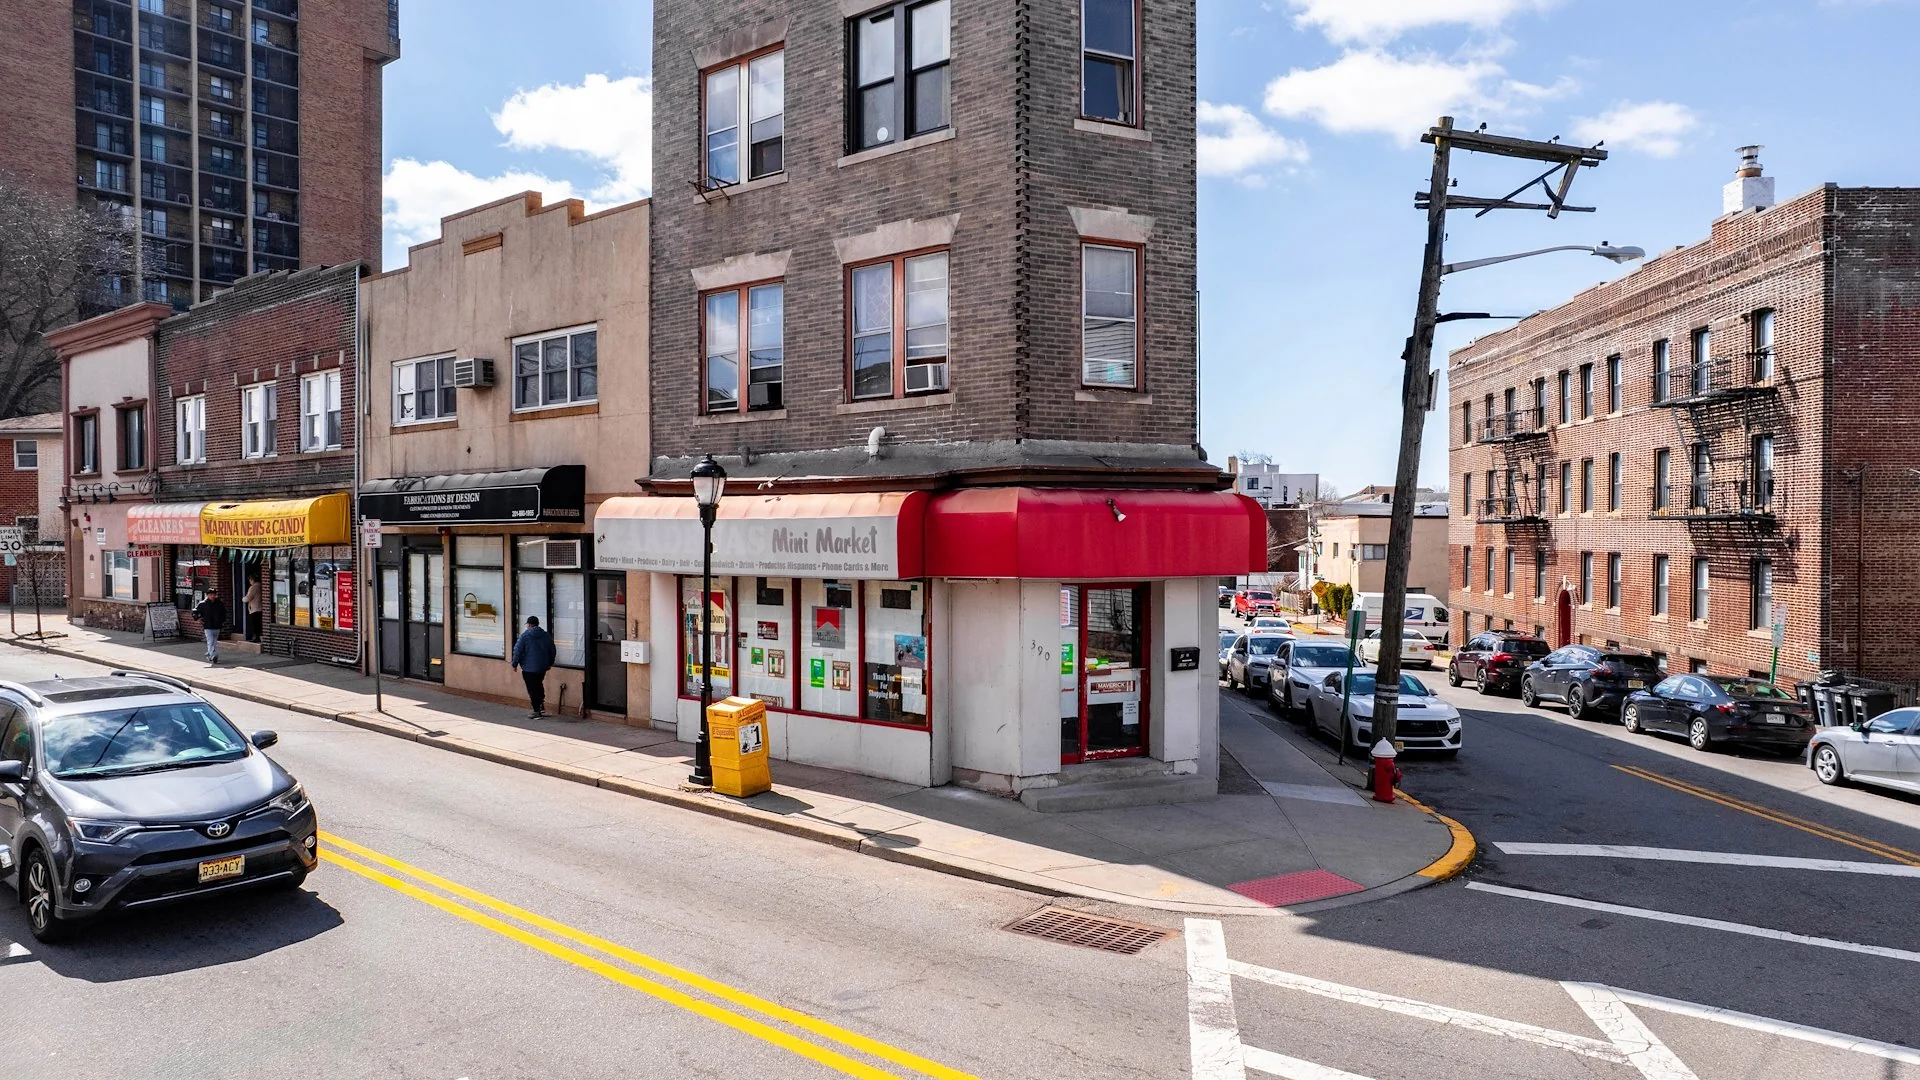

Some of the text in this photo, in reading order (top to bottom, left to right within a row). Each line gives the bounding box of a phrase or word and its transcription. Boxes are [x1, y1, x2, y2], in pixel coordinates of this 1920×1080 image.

[403, 492, 480, 505] FABRICATIONS BY DESIGN
[137, 519, 184, 534] CLEANERS
[204, 516, 306, 537] MARINA NEWS & CANDY
[0, 540, 21, 551] 30
[772, 527, 809, 554] Mini
[816, 525, 878, 554] Market
[127, 550, 162, 558] CLEANERS
[599, 555, 618, 565] Grocery
[637, 557, 658, 566] Produce
[661, 558, 676, 567] Dairy
[679, 559, 690, 567] Deli
[710, 560, 735, 569] andwich
[738, 561, 754, 569] Drink
[787, 561, 817, 571] Hispanos
[821, 562, 842, 571] Phone
[843, 562, 863, 572] Cards
[864, 563, 870, 571] &
[870, 563, 889, 572] More
[1031, 640, 1051, 661] 390
[872, 672, 887, 681] Thank
[880, 681, 889, 690] For
[868, 689, 889, 700] Shopping
